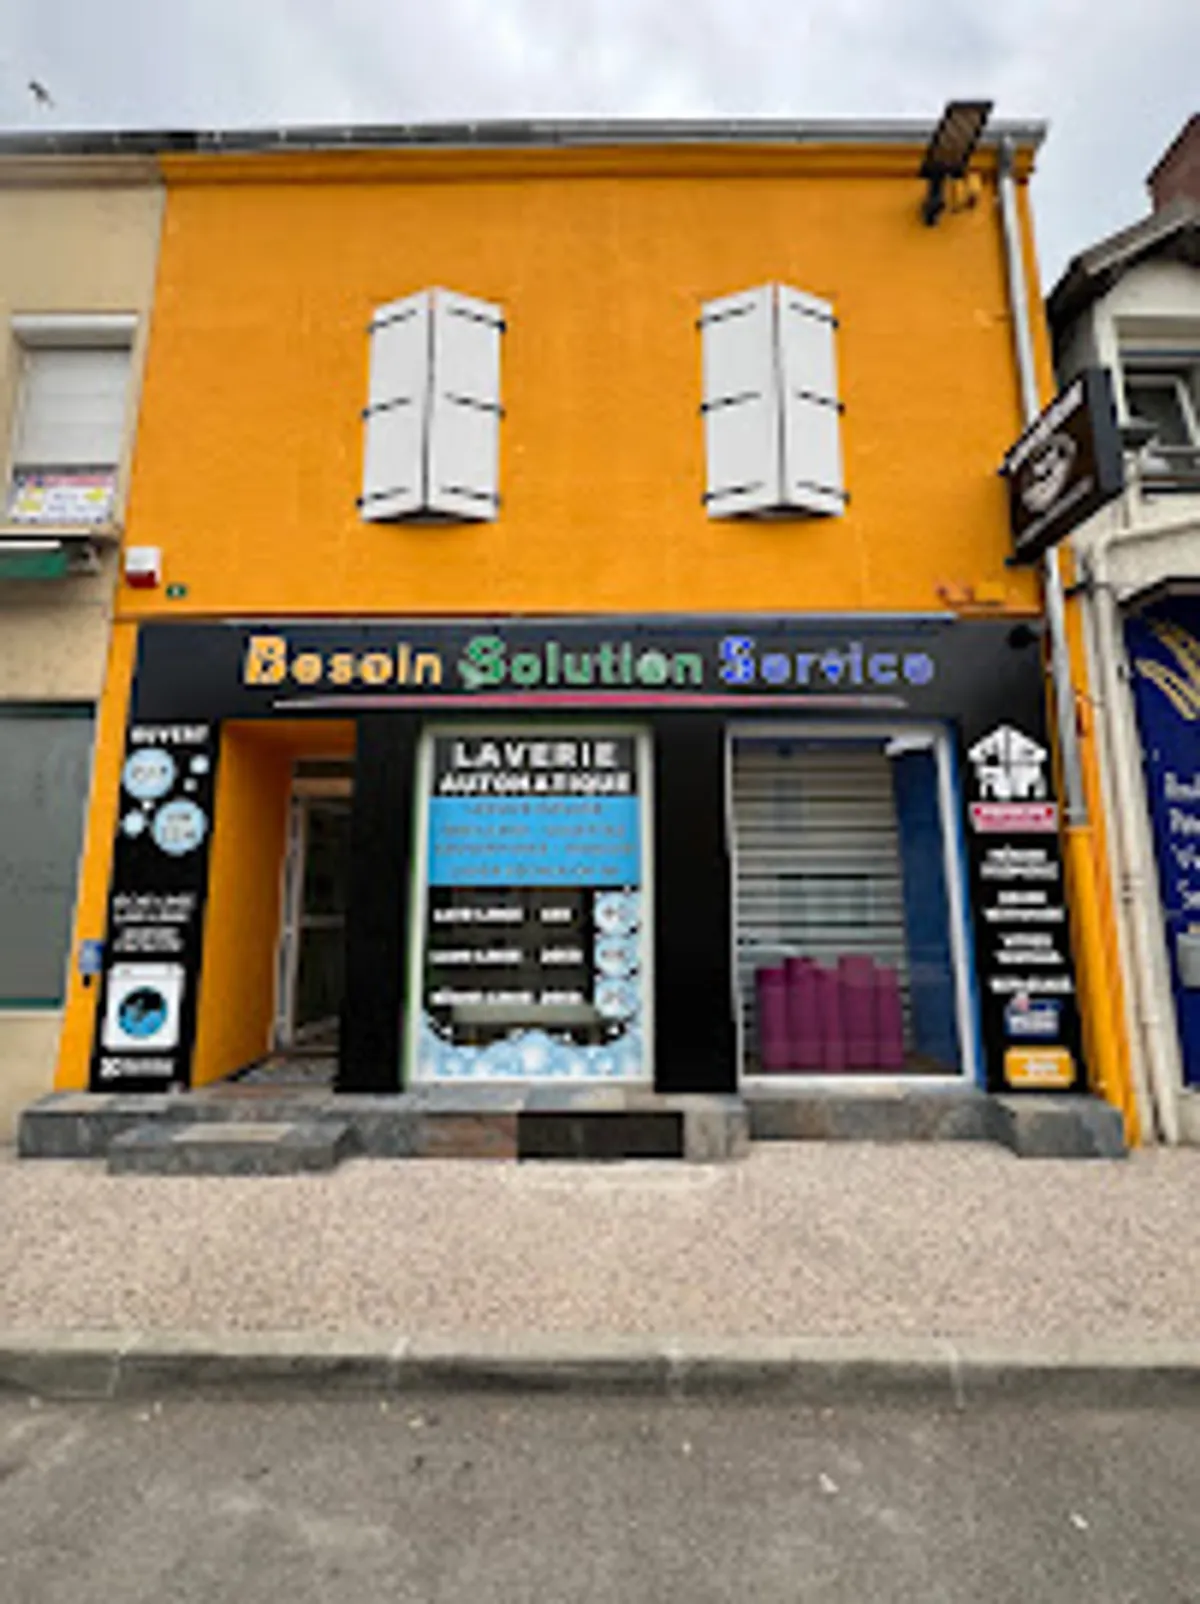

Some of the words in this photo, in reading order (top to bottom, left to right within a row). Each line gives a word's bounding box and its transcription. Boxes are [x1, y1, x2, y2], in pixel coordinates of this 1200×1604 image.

[244, 636, 442, 685] Besoin
[458, 636, 703, 689] Solution
[719, 636, 934, 685] Service
[455, 742, 618, 767] LAVERIE
[439, 772, 631, 792] AUTOMATIQUE
